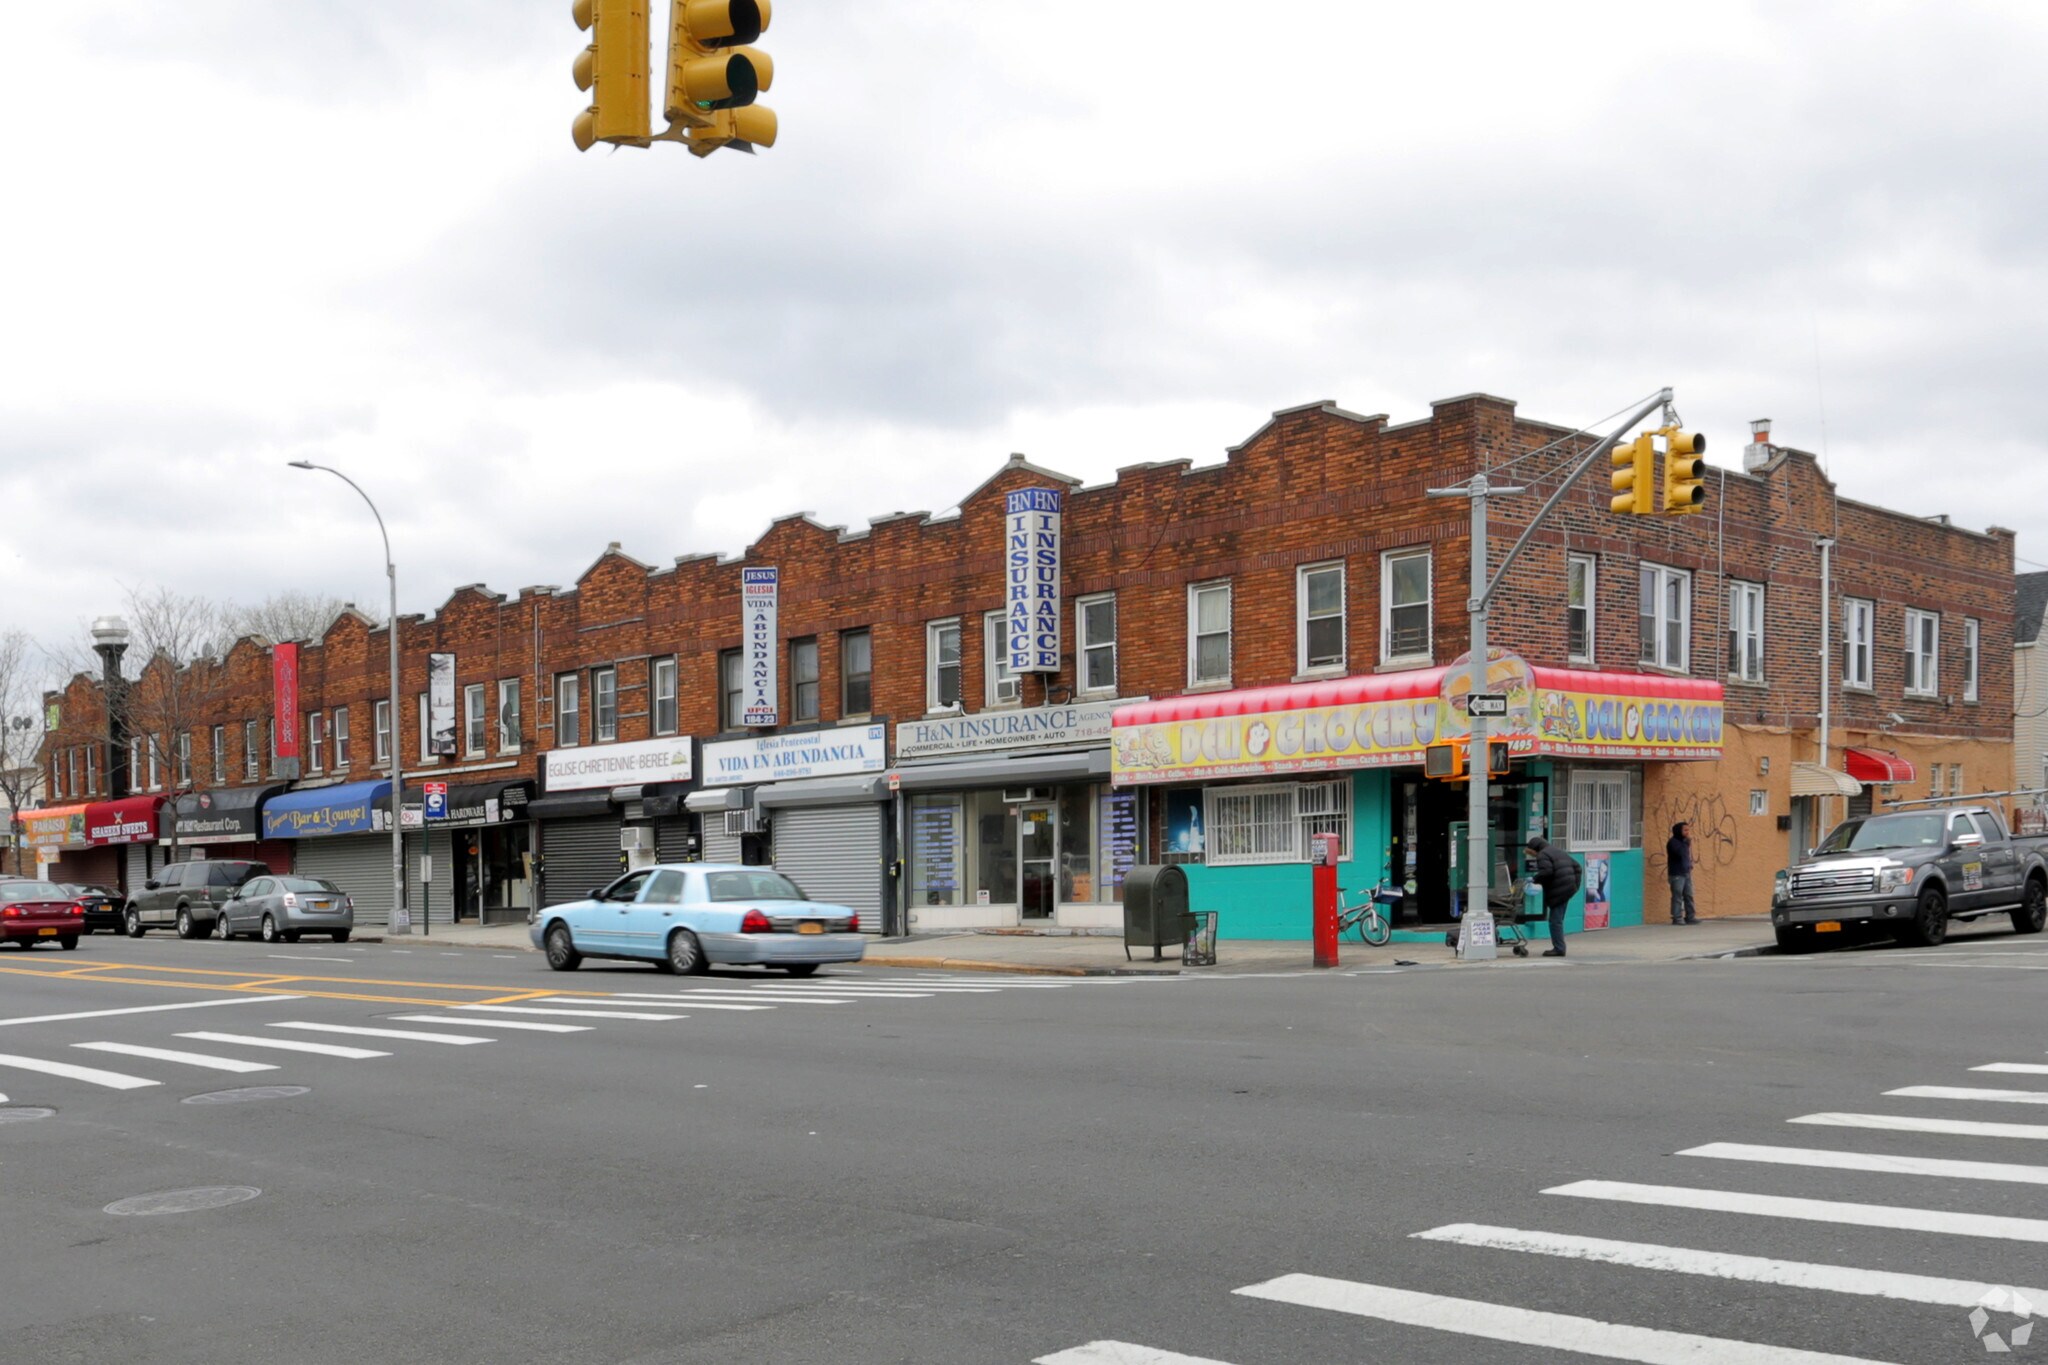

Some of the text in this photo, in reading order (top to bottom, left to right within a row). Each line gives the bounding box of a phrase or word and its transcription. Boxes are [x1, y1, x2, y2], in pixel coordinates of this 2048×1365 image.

[745, 571, 775, 582] JESUS
[745, 585, 774, 594] IGLESIA
[1010, 516, 1029, 668] INSURANCE
[1036, 515, 1056, 666] INSURANCE
[747, 600, 773, 608] VIDA
[753, 613, 767, 706] ABUNDANCIA
[1473, 701, 1503, 710] ONE WAY
[916, 723, 954, 743] H&N
[959, 709, 1077, 738] INSURANCE
[1586, 699, 1622, 739] DELI
[1642, 703, 1721, 742] GROCERY
[906, 731, 1066, 753] COMMERCIAL LIFE HOMEOWNER AUTO
[1181, 721, 1241, 763] DELI
[1276, 703, 1437, 755] GROCERY
[756, 738, 779, 751] Iglesia
[548, 752, 669, 778] EGLISE CHRETIENNE BEREE
[718, 757, 749, 772] VIDA
[753, 754, 769, 769] EN
[773, 743, 865, 767] ABUNDANCIA
[289, 811, 312, 829] Bar
[313, 811, 320, 823] &
[321, 807, 360, 826] Lounge
[451, 806, 485, 819] HARDWARE
[122, 821, 148, 835] SWEETS
[194, 819, 225, 832] Restaurant
